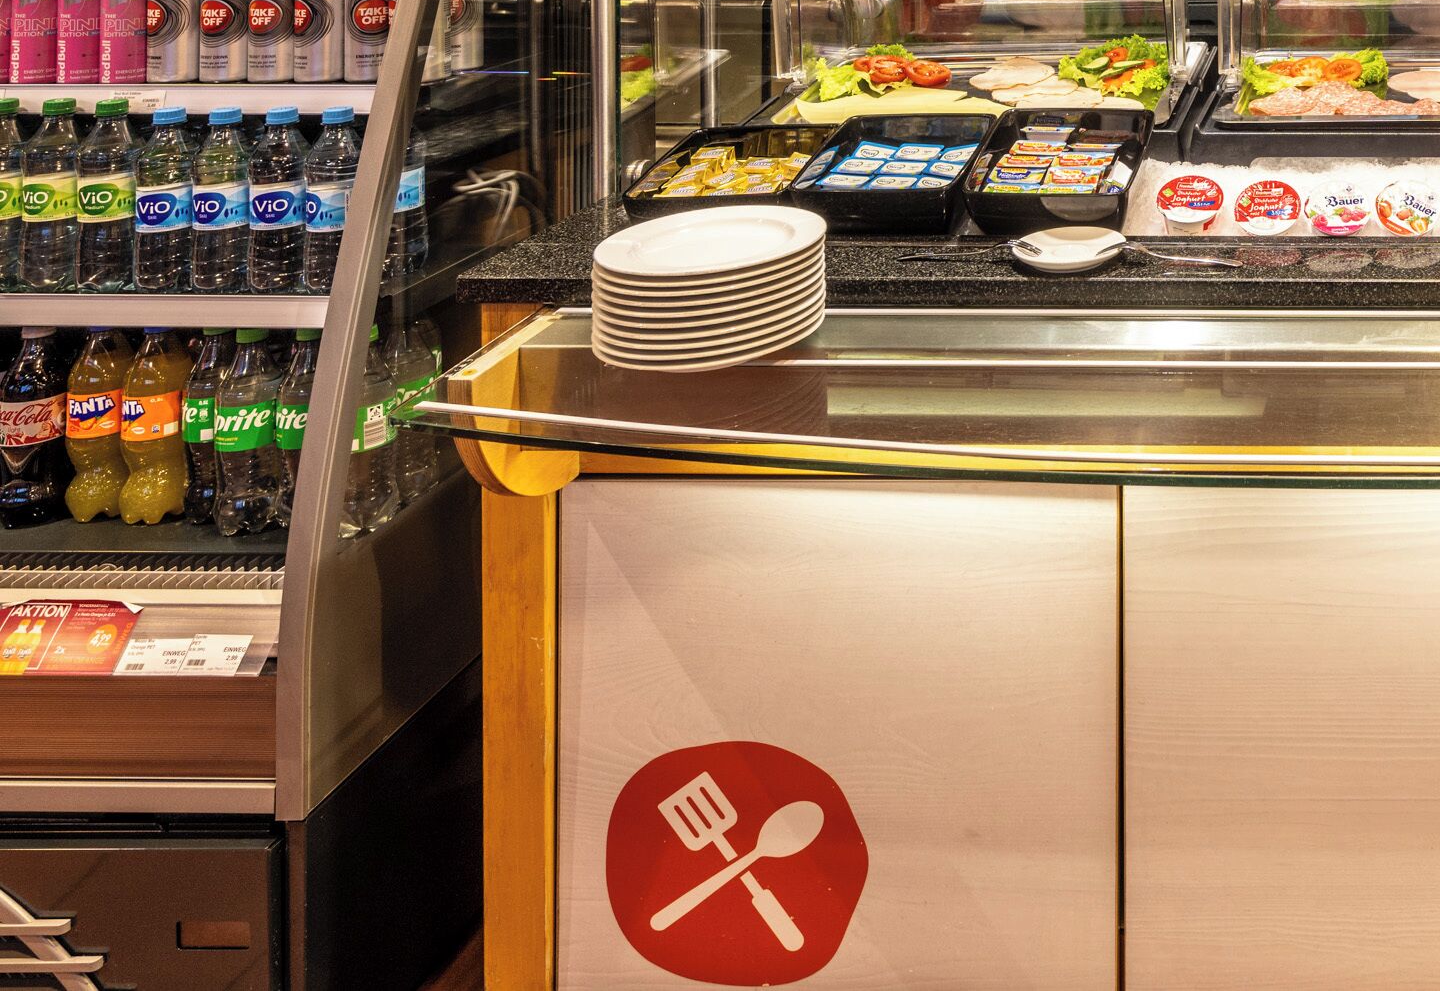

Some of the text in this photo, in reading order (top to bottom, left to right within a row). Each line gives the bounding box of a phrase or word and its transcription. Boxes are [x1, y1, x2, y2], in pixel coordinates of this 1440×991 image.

[202, 9, 227, 26] TAKE OFF
[250, 8, 275, 26] TAKE OFF
[360, 7, 390, 25] TAKE OFF
[10, 40, 20, 84] Red Bull
[58, 40, 66, 84] Red Bull
[101, 40, 111, 84] Red Bull
[23, 190, 49, 204] ViO
[80, 190, 113, 205] ViO
[1171, 194, 1206, 203] Joghurt
[1325, 195, 1364, 207] Bauer
[1403, 192, 1437, 217] Bauer
[138, 200, 171, 215] ViO
[193, 199, 220, 214] ViO
[254, 198, 289, 213] ViO
[1250, 202, 1284, 212] Joghurt
[69, 396, 115, 415] FANTA
[122, 400, 145, 416] NTA
[214, 407, 269, 434] prite
[10, 605, 68, 618] AKTION
